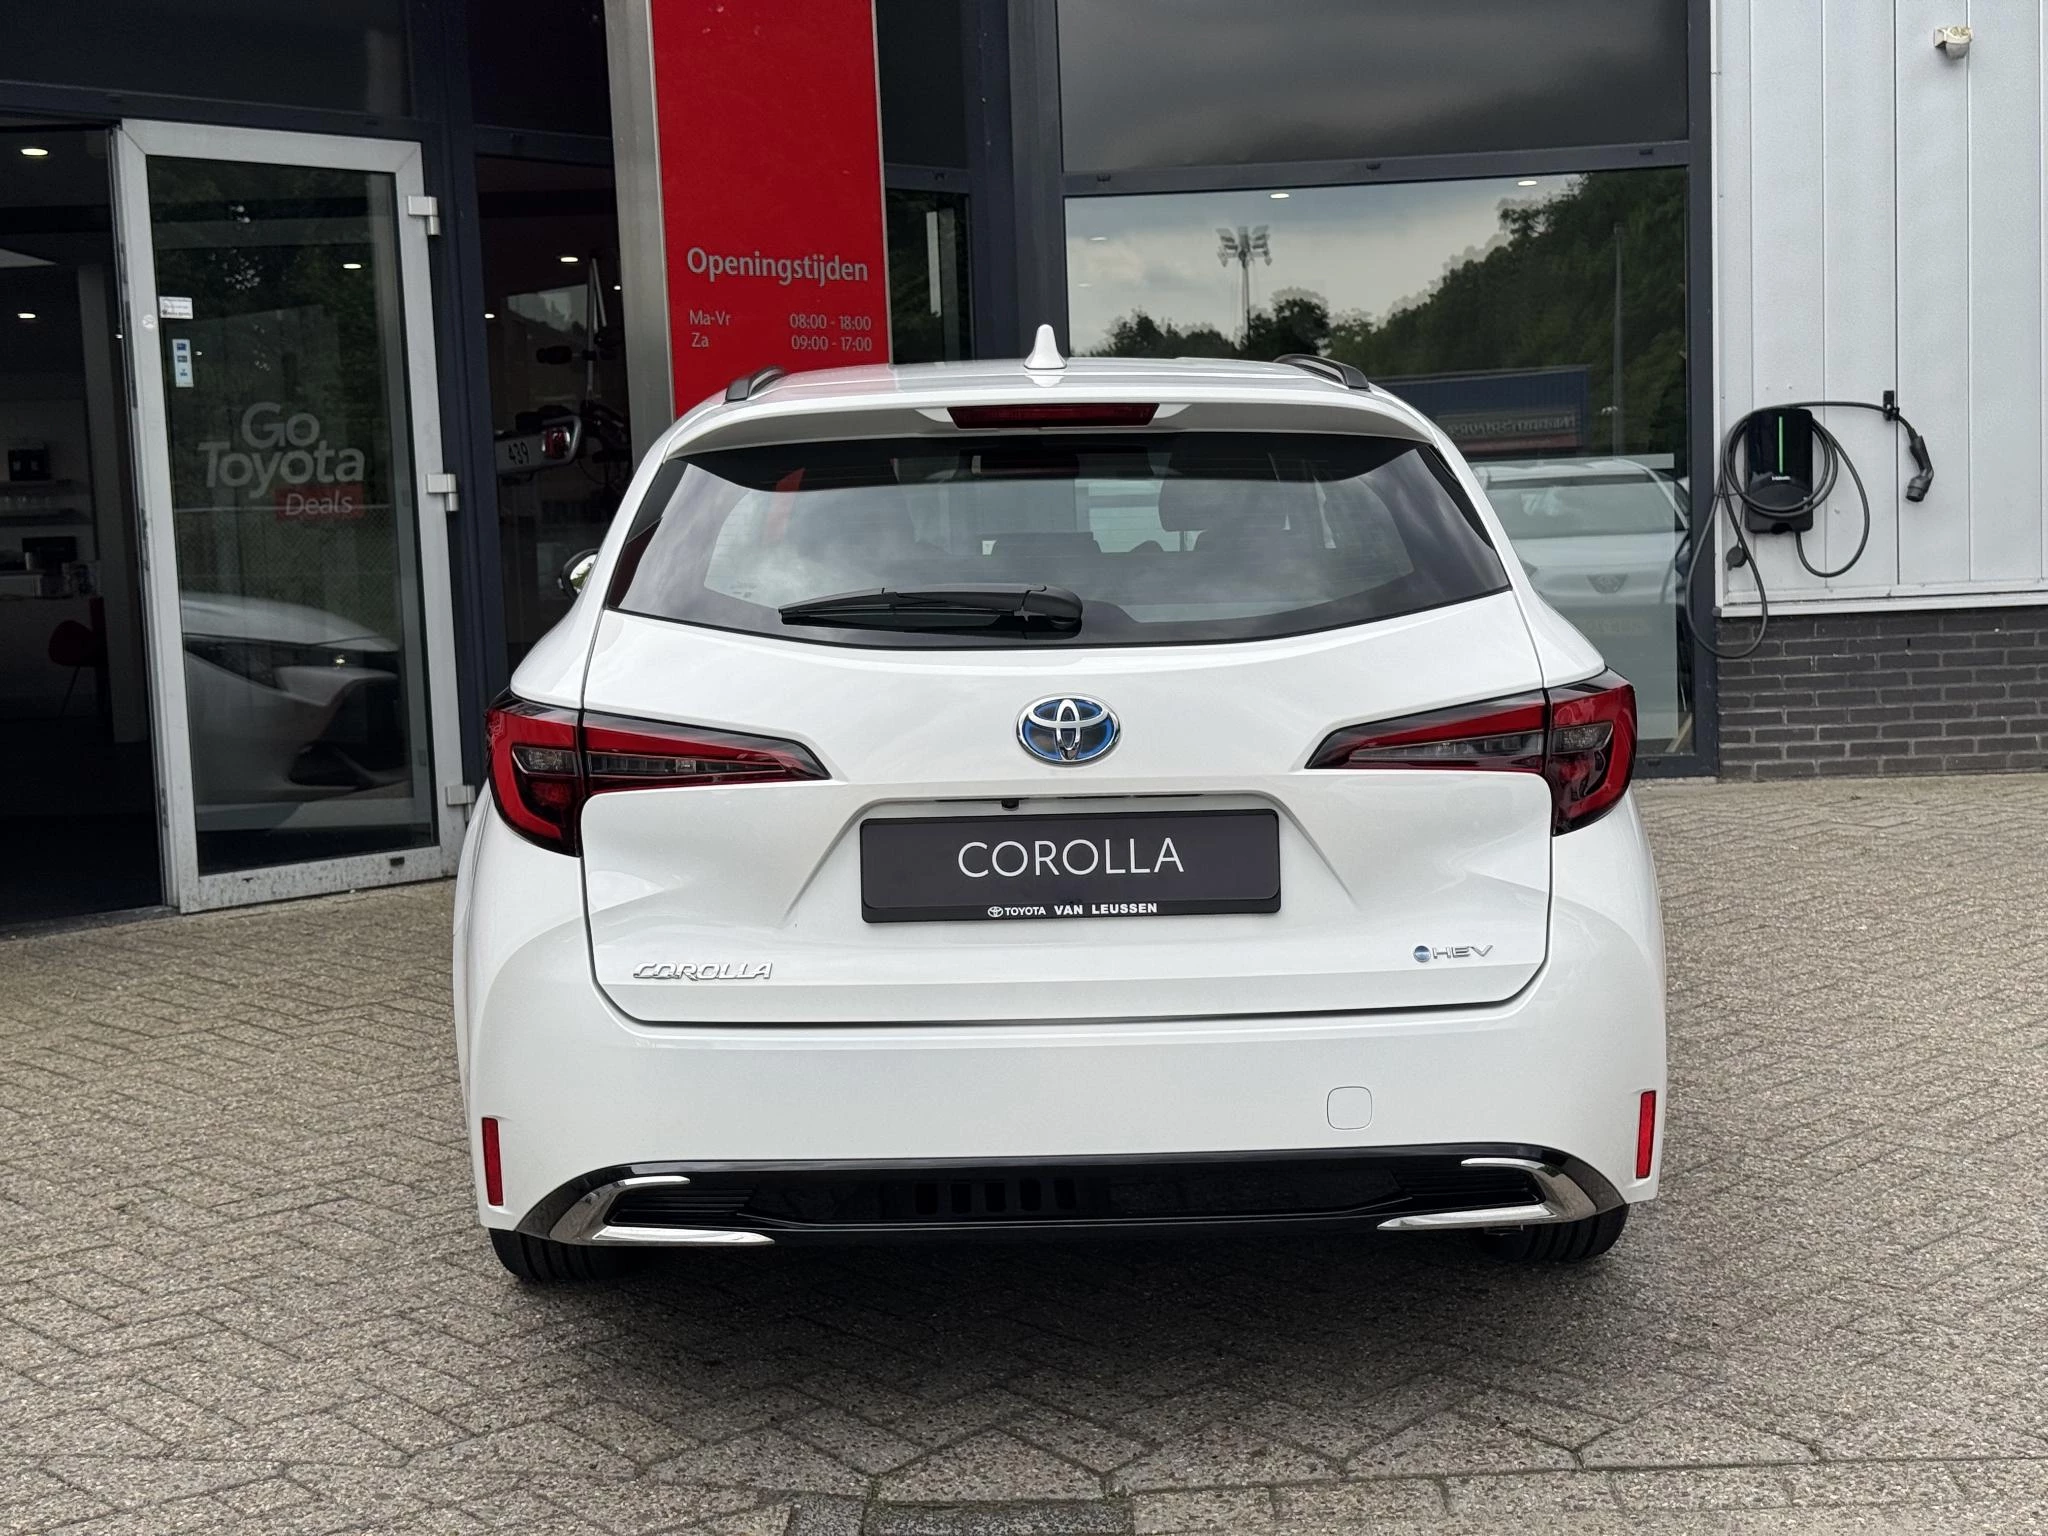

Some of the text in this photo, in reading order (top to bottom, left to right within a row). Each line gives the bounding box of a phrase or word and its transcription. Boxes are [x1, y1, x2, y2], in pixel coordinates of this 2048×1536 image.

[687, 247, 868, 287] Openingstijden
[689, 309, 731, 326] Ma-Vr
[790, 313, 827, 329] 08:00
[840, 315, 872, 331] 18:00
[692, 332, 709, 348] Za
[791, 335, 829, 350] 09:00
[841, 336, 873, 351] 17:00
[241, 402, 320, 449] Go
[508, 441, 530, 465] 439
[197, 439, 366, 498] Toyota
[285, 489, 353, 516] Deals
[958, 837, 1185, 878] COROLLA
[1005, 902, 1158, 917] TOYOTA VAN LEUSSEN
[1432, 944, 1494, 960] HEV
[632, 961, 773, 981] COROLLA
